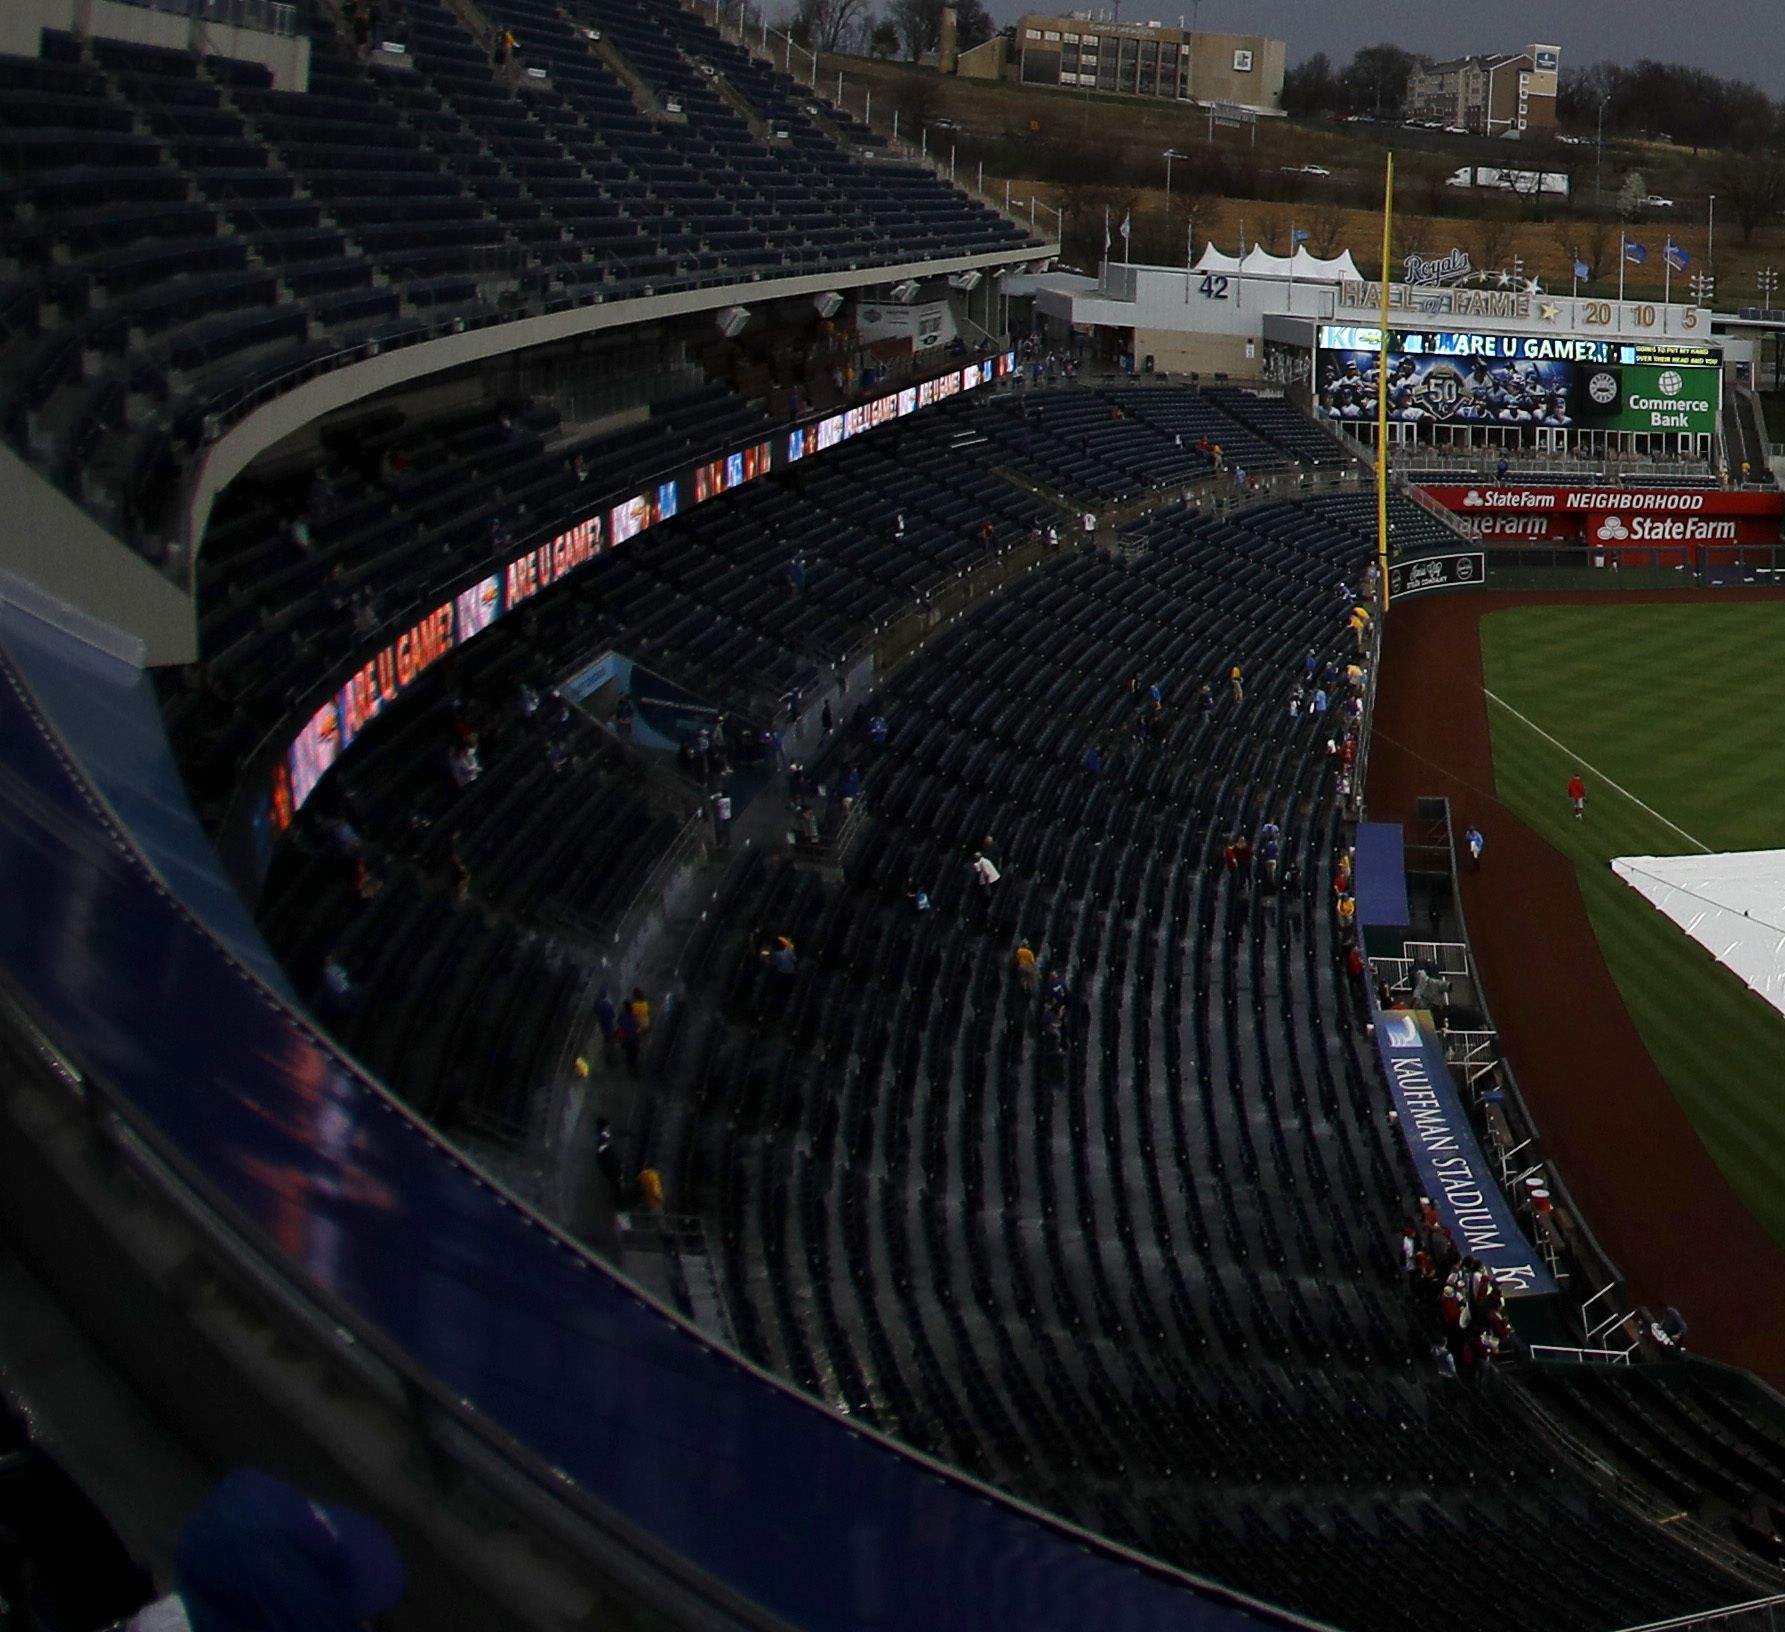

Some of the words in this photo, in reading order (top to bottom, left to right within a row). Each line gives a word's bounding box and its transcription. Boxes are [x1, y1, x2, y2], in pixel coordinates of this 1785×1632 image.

[1404, 248, 1472, 287] Royals
[1200, 274, 1229, 299] 42
[1340, 279, 1419, 313] HALL
[1450, 288, 1530, 318] FAME
[1583, 302, 1611, 325] 20
[1631, 305, 1655, 327] 10
[1682, 307, 1697, 329] 5
[1454, 334, 1496, 355] ARE
[1503, 337, 1517, 356] U
[1524, 338, 1597, 362] GAME?
[1427, 378, 1457, 404] 50
[1629, 395, 1709, 412] Commerce
[1651, 412, 1689, 427] Bank
[1566, 492, 1703, 510] NEIGHBORHOOD
[1391, 1057, 1459, 1152] KAUFFMAN
[1432, 1156, 1505, 1253] STADIUM
